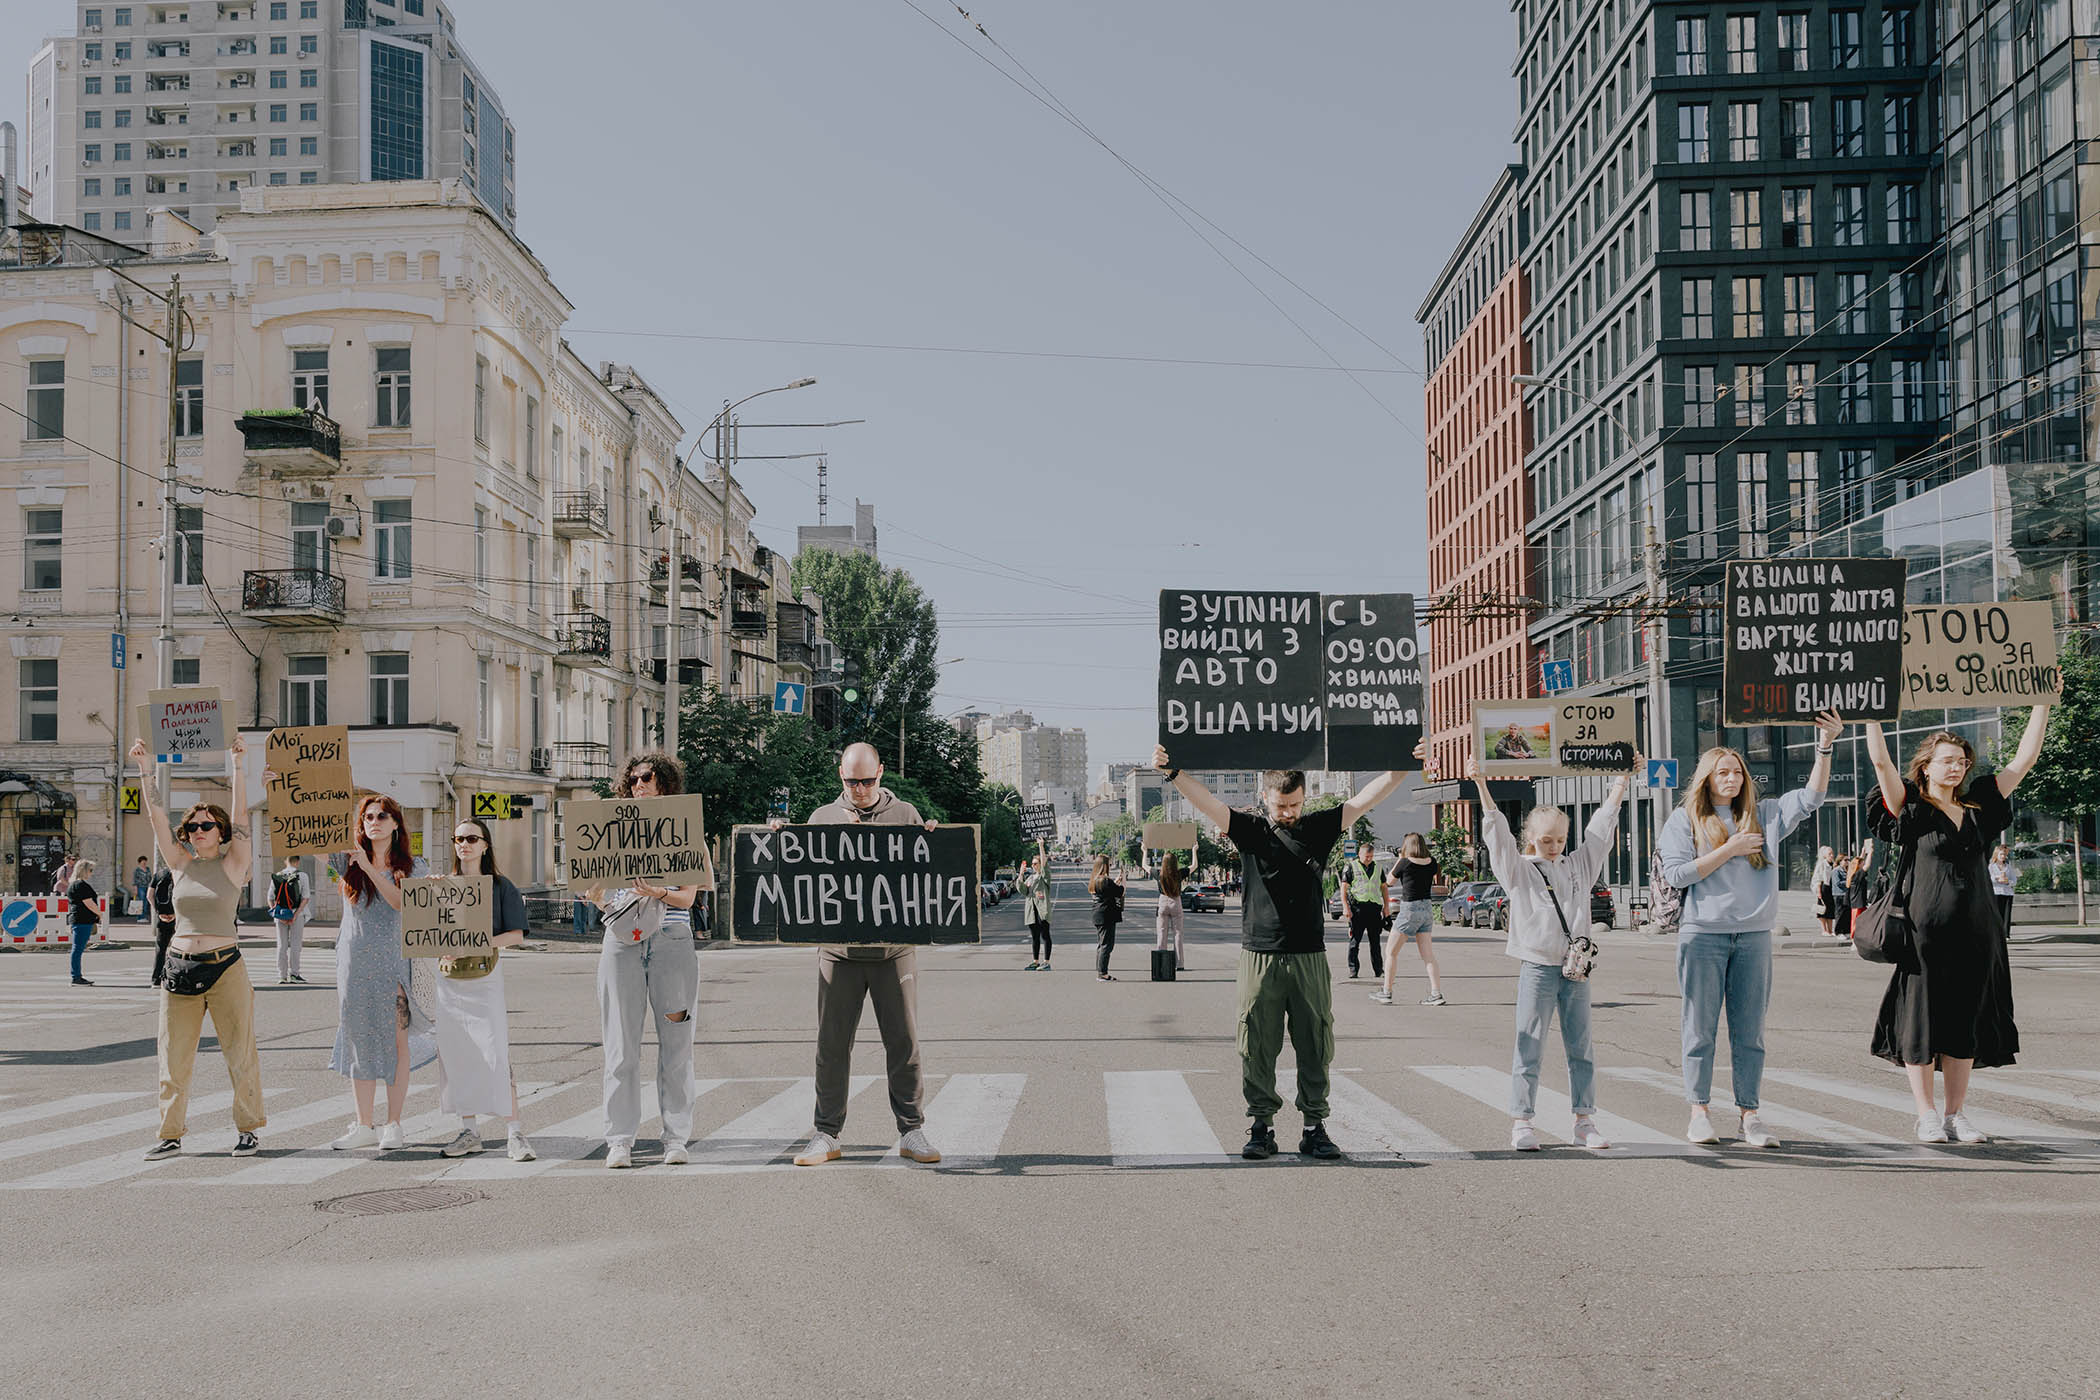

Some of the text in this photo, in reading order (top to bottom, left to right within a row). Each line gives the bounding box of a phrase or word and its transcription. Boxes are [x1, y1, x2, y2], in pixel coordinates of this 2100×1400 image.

[1735, 564, 1845, 588] ХВИЛИНА
[1736, 588, 1895, 617] ВАШОГО ЖИТТЯ
[1163, 625, 1263, 654] ВИЙДИ
[1736, 619, 1898, 650] ВАРТУЄ ЦІЛОГО
[1327, 637, 1417, 664] 09:00
[2003, 642, 2034, 665] ЗА
[1175, 657, 1277, 686] АВТО
[1773, 651, 1854, 676] ЖИТТЯ
[1327, 668, 1422, 687] ХВИЛИНА
[1327, 691, 1400, 710] МОВЧА
[1743, 677, 1885, 713] 9:00 ВШАНУЙ
[1167, 697, 1321, 735] ВШАНУЙ
[1373, 709, 1418, 726] ННЯ
[1563, 705, 1615, 720] СТОЮ
[270, 732, 304, 750] Мої
[1575, 725, 1597, 740] ЗА
[1562, 749, 1623, 761] ІСТОРИКА
[272, 771, 300, 792] НЕ
[615, 805, 640, 820] 9:00
[286, 826, 349, 848] ВШАНУЙ!
[576, 818, 688, 851] ЗУПИНИСЬ!
[750, 831, 930, 865] ХВИЛИНА
[571, 852, 621, 879] ВШАНУЙ
[753, 873, 966, 927] МОВЧАННЯ
[438, 908, 456, 924] НЕ
[405, 928, 490, 948] СТАТИСТИКА
